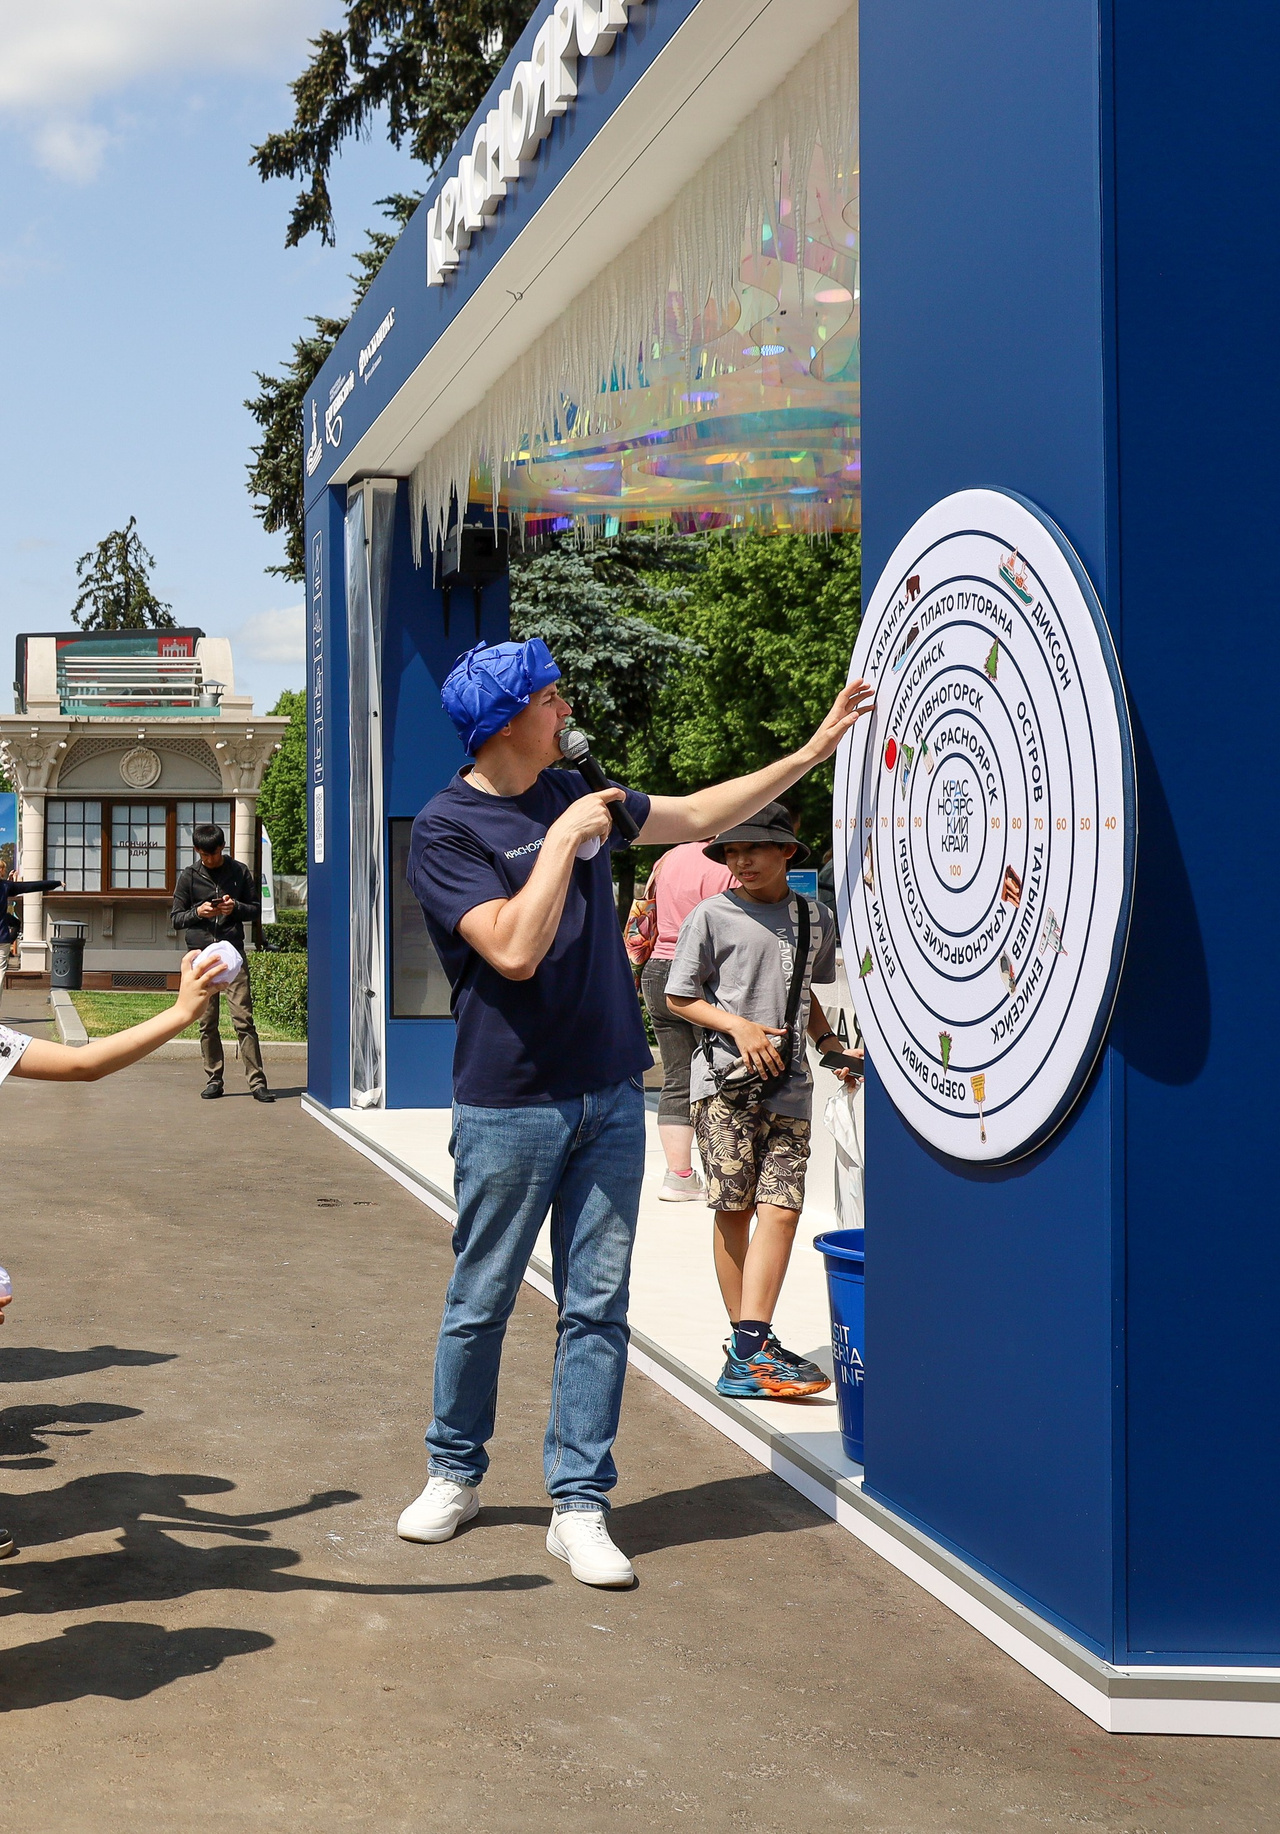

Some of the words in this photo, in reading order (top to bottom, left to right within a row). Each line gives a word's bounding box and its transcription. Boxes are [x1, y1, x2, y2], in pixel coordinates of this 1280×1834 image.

[427, 0, 644, 287] КРАСНОЯРС
[920, 594, 954, 631] ПЛАТО
[957, 592, 1013, 639] ПУТОРАНА
[870, 600, 906, 678] ХАТАНГА
[1031, 601, 1071, 691] ДИКСОН
[892, 640, 946, 737] МИНУСИНСК
[912, 682, 984, 744] ДИВНОГОРСК
[1016, 701, 1043, 803] ОСТРОВ
[933, 726, 999, 807] КРАСНОЯРСК
[943, 779, 969, 798] КРАС
[937, 798, 974, 816] НОЯРС
[835, 819, 842, 829] 40
[849, 818, 857, 829] 50
[864, 818, 873, 829] 60
[880, 817, 889, 828] 70
[896, 817, 905, 828] 80
[913, 817, 923, 828] 90
[946, 816, 969, 834] КИЙ
[990, 817, 1001, 829] 90
[1011, 818, 1022, 829] 80
[1033, 818, 1044, 830] 70
[1056, 818, 1067, 830] 60
[1080, 818, 1091, 830] 50
[1104, 817, 1117, 830] 40
[119, 840, 158, 848] ПОНЧИКИ
[941, 834, 969, 853] КРАЙ
[949, 864, 962, 876] 100
[899, 838, 924, 929] СТОЛБЫ
[1011, 843, 1044, 960] ТАТЫШЕВ
[871, 900, 897, 979] ЕРГАКИ
[923, 901, 1007, 965] КРАСНОЯРСКИЕ
[990, 956, 1044, 1045] ЕНИСЕЙСК
[901, 1041, 931, 1088] ВИВИ
[931, 1075, 966, 1102] ОЗЕРО
